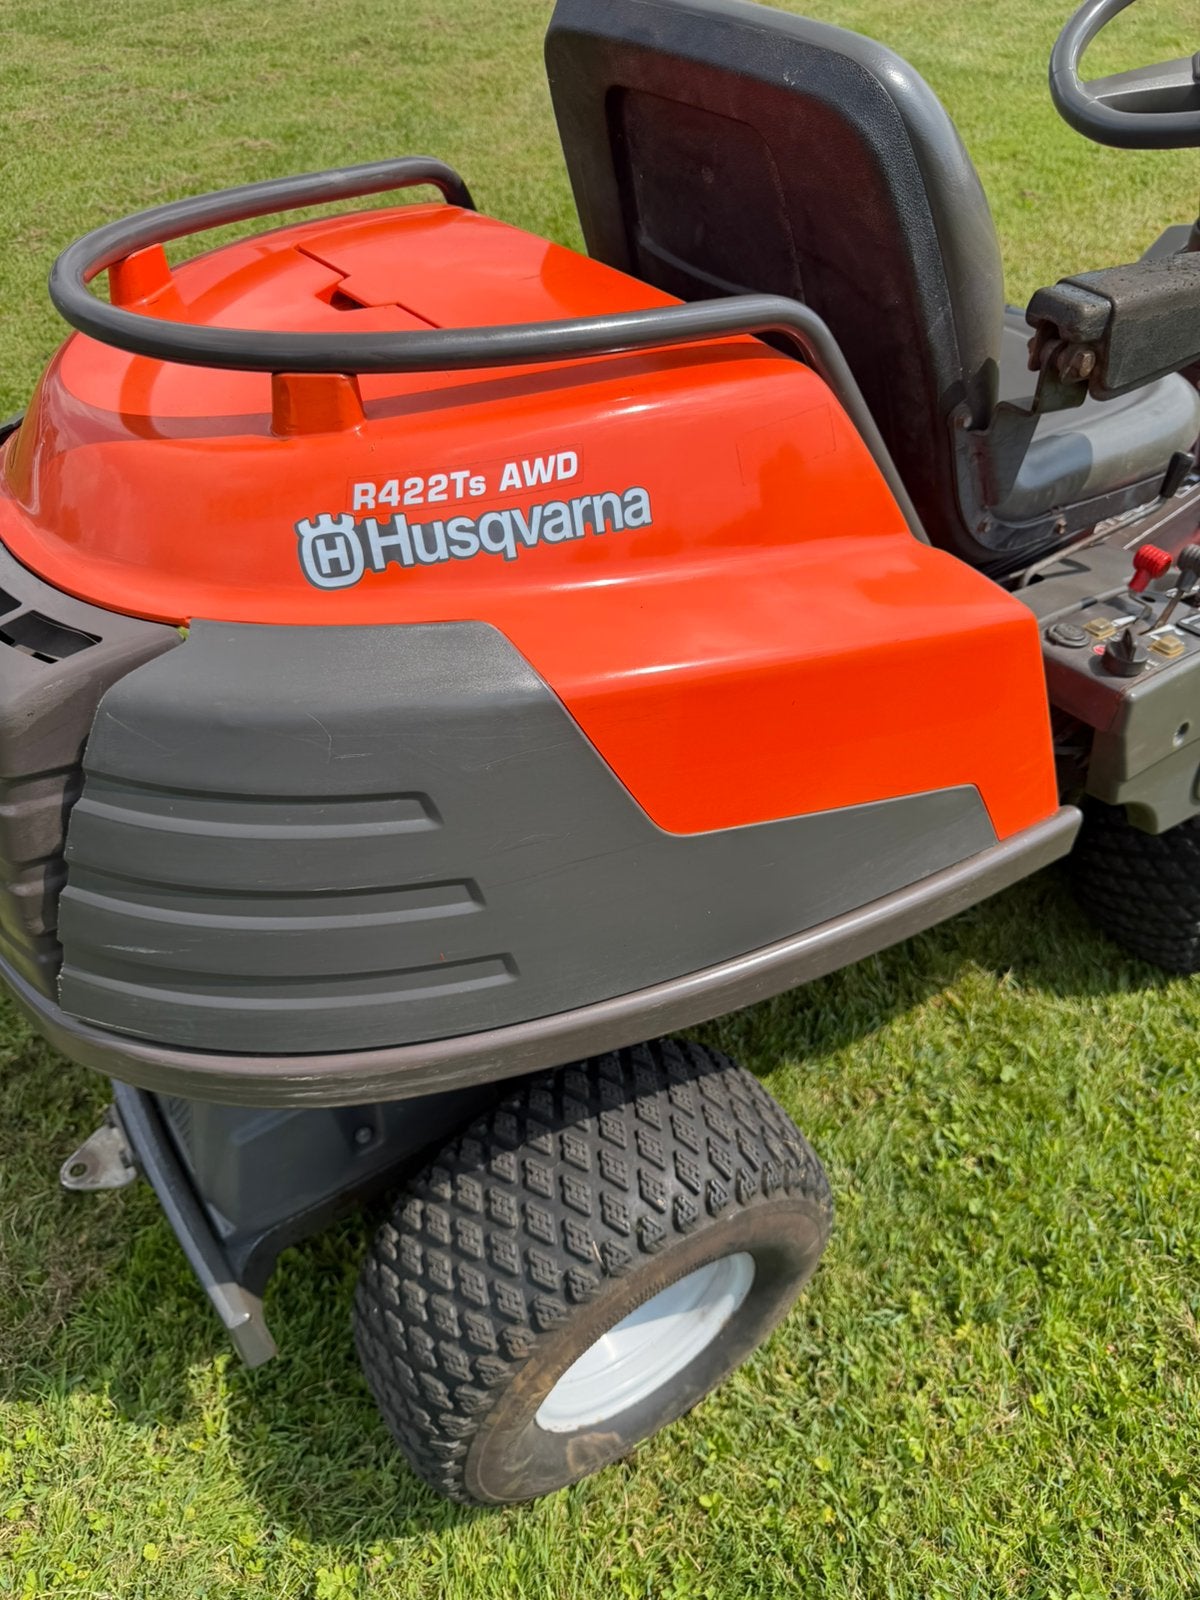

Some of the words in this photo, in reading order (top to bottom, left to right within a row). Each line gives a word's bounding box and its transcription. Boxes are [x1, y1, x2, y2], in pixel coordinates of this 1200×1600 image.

[353, 470, 487, 511] R422Ts
[499, 451, 578, 491] AWD
[365, 487, 652, 570] Husqvarna
